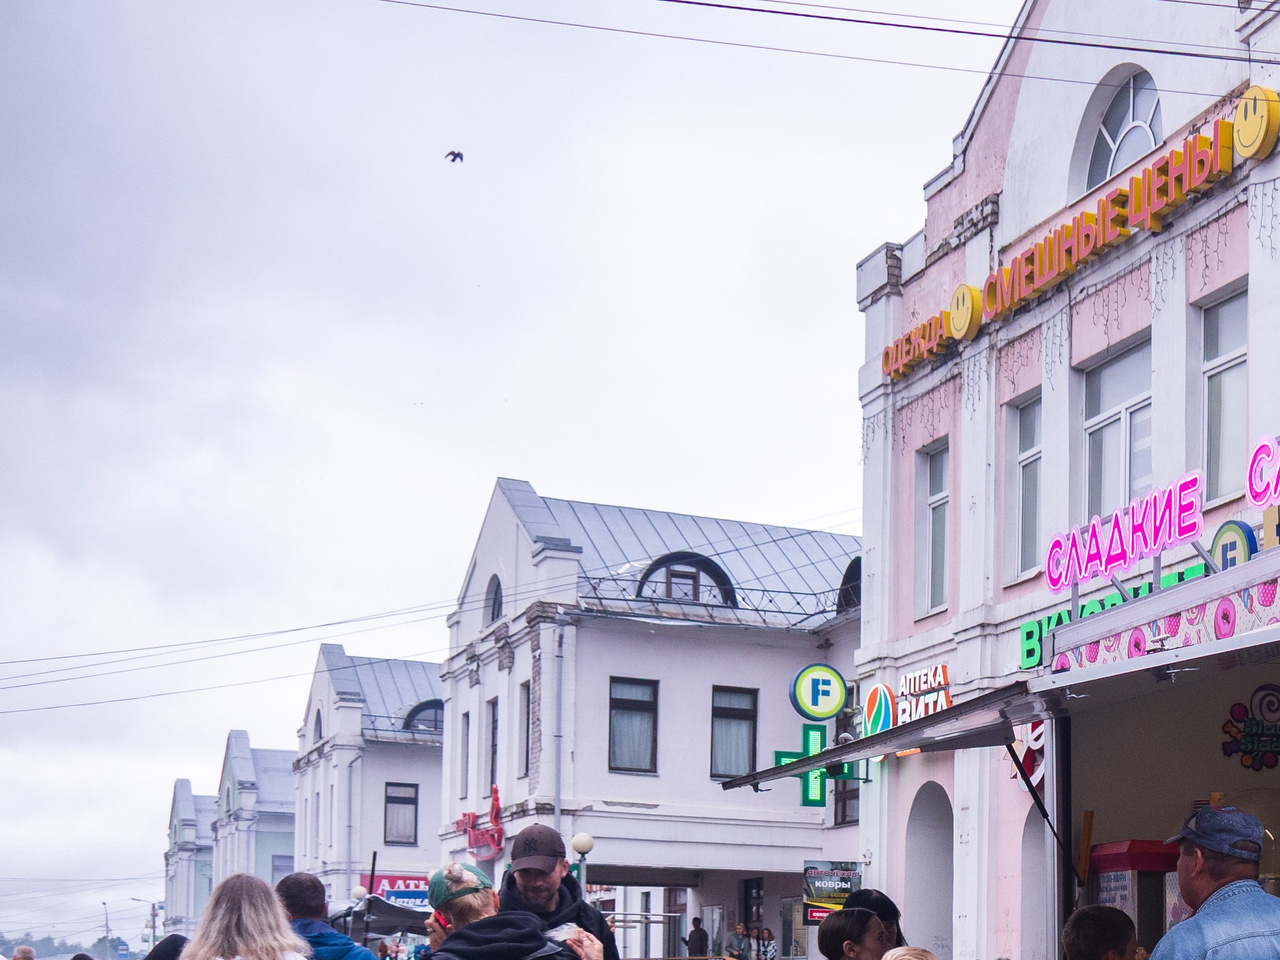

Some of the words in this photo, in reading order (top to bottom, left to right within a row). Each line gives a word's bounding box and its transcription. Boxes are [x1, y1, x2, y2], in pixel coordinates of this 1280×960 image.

[983, 190, 1129, 321] СМЕШНЫЕ
[1127, 120, 1231, 231] ЦЕНЫ
[882, 311, 950, 378] ОДЕЖДА
[1046, 472, 1203, 594] СЛАДКИЕ
[811, 678, 831, 707] F
[898, 664, 947, 697] АПТЕКА
